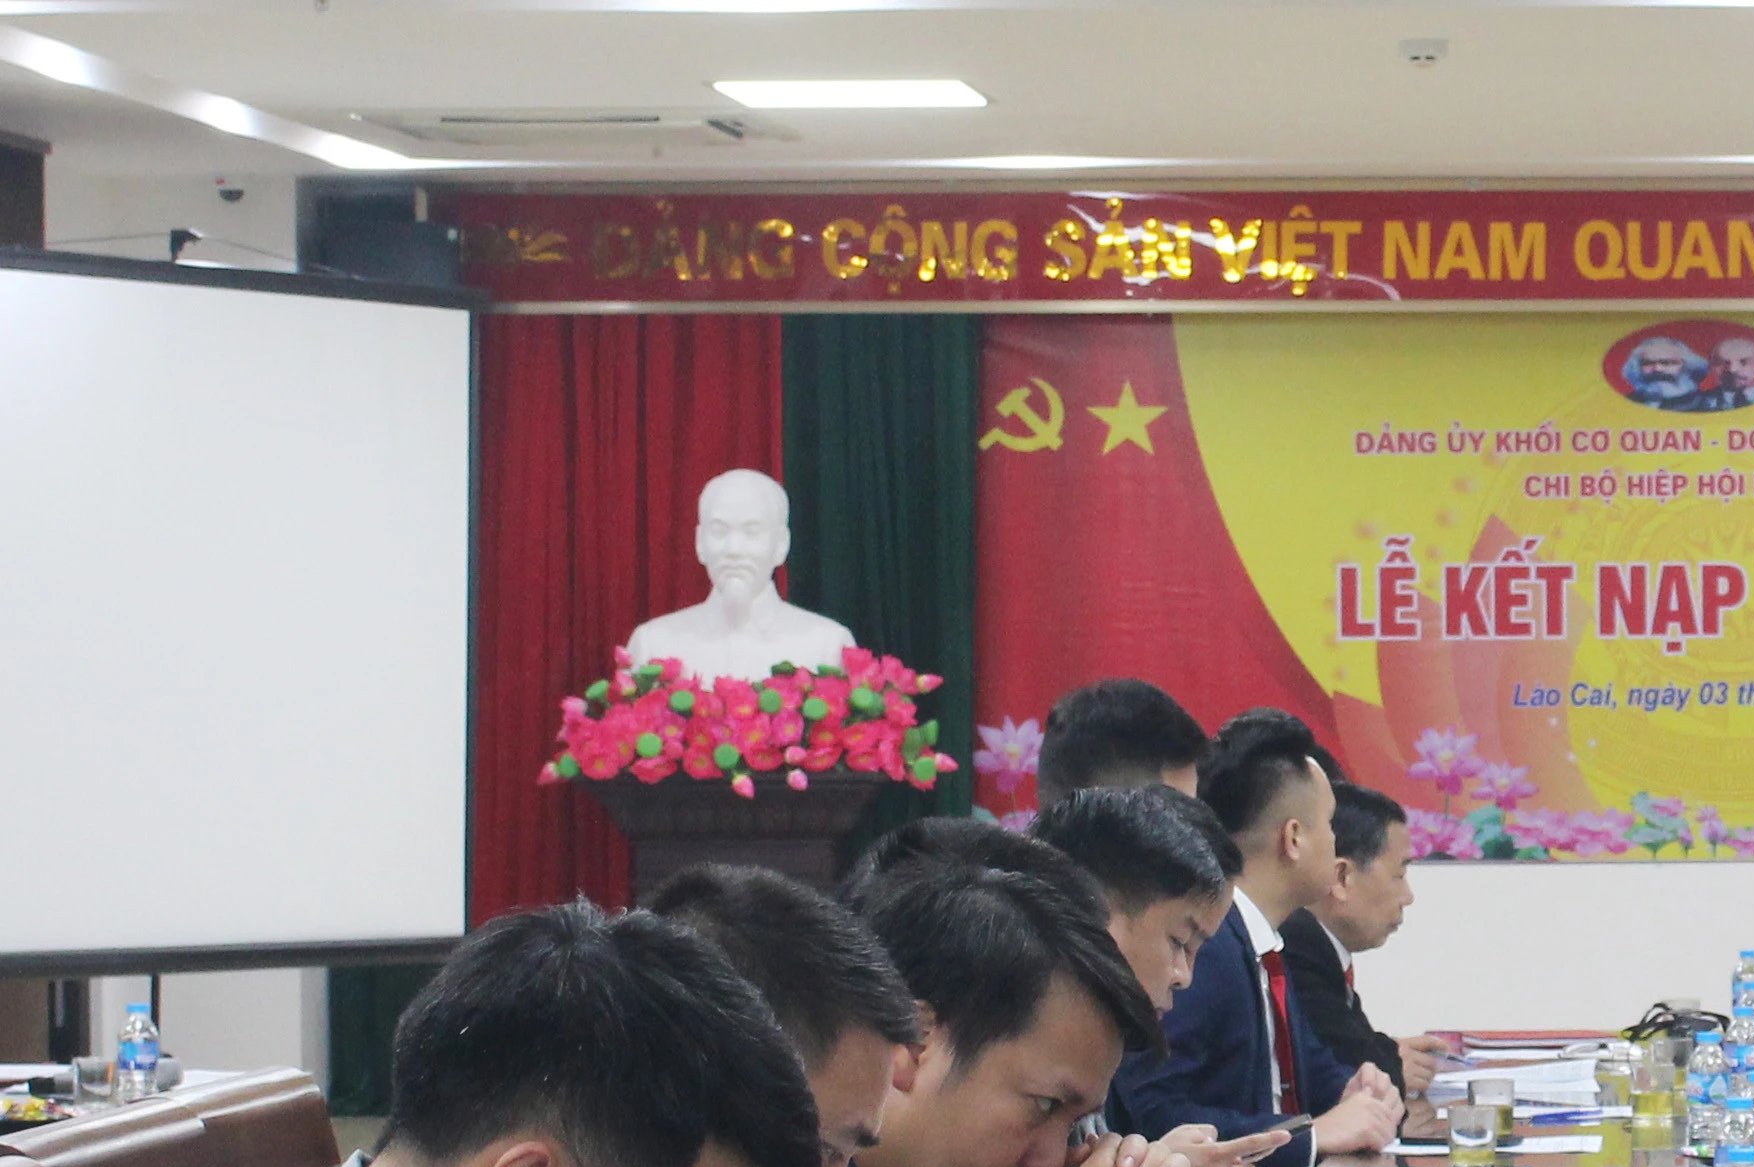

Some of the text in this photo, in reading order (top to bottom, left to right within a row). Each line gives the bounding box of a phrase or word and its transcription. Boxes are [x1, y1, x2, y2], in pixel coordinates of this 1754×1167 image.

[822, 204, 1019, 293] CỘNG
[1044, 197, 1192, 281] SẢN
[1209, 204, 1363, 296] VIỆT
[1382, 220, 1546, 280] NAM
[1447, 420, 1486, 454] ỦY
[1496, 420, 1563, 453] KHỐI
[1571, 428, 1610, 453] CƠ
[1620, 429, 1702, 453] QUAN
[1523, 475, 1571, 498] CHI
[1580, 468, 1617, 505] BỘ
[1627, 468, 1689, 504] HIỆP
[1697, 467, 1745, 504] HỘI
[1339, 534, 1421, 639] LỄ
[1443, 535, 1575, 640] KẾT
[1598, 562, 1747, 654] NẠP
[1569, 682, 1618, 711] Cai,
[1626, 681, 1692, 712] ngày
[1698, 681, 1730, 706] 03
